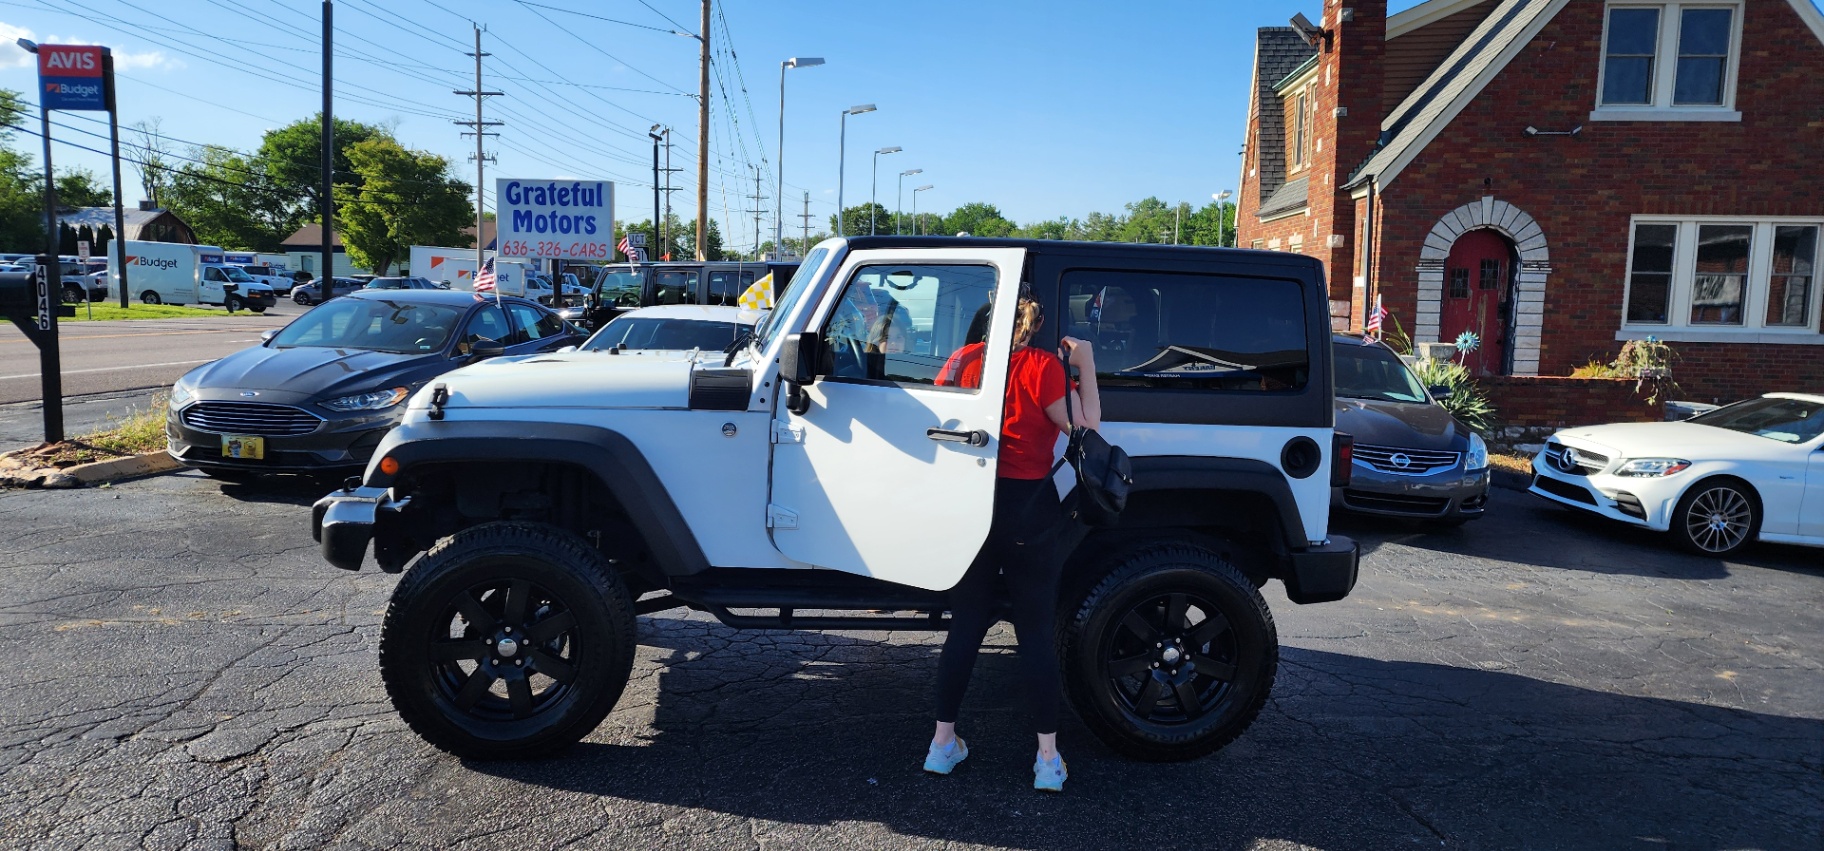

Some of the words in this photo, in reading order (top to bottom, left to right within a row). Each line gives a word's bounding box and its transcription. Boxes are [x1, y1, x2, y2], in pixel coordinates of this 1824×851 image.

[47, 51, 95, 69] AVIS
[60, 83, 99, 97] Budget
[505, 181, 603, 207] Grateful
[512, 209, 597, 235] Motors
[630, 234, 645, 244] JCT
[503, 240, 607, 258] 636-326-CARS
[140, 256, 178, 270] Budget
[37, 265, 49, 329] 4046
